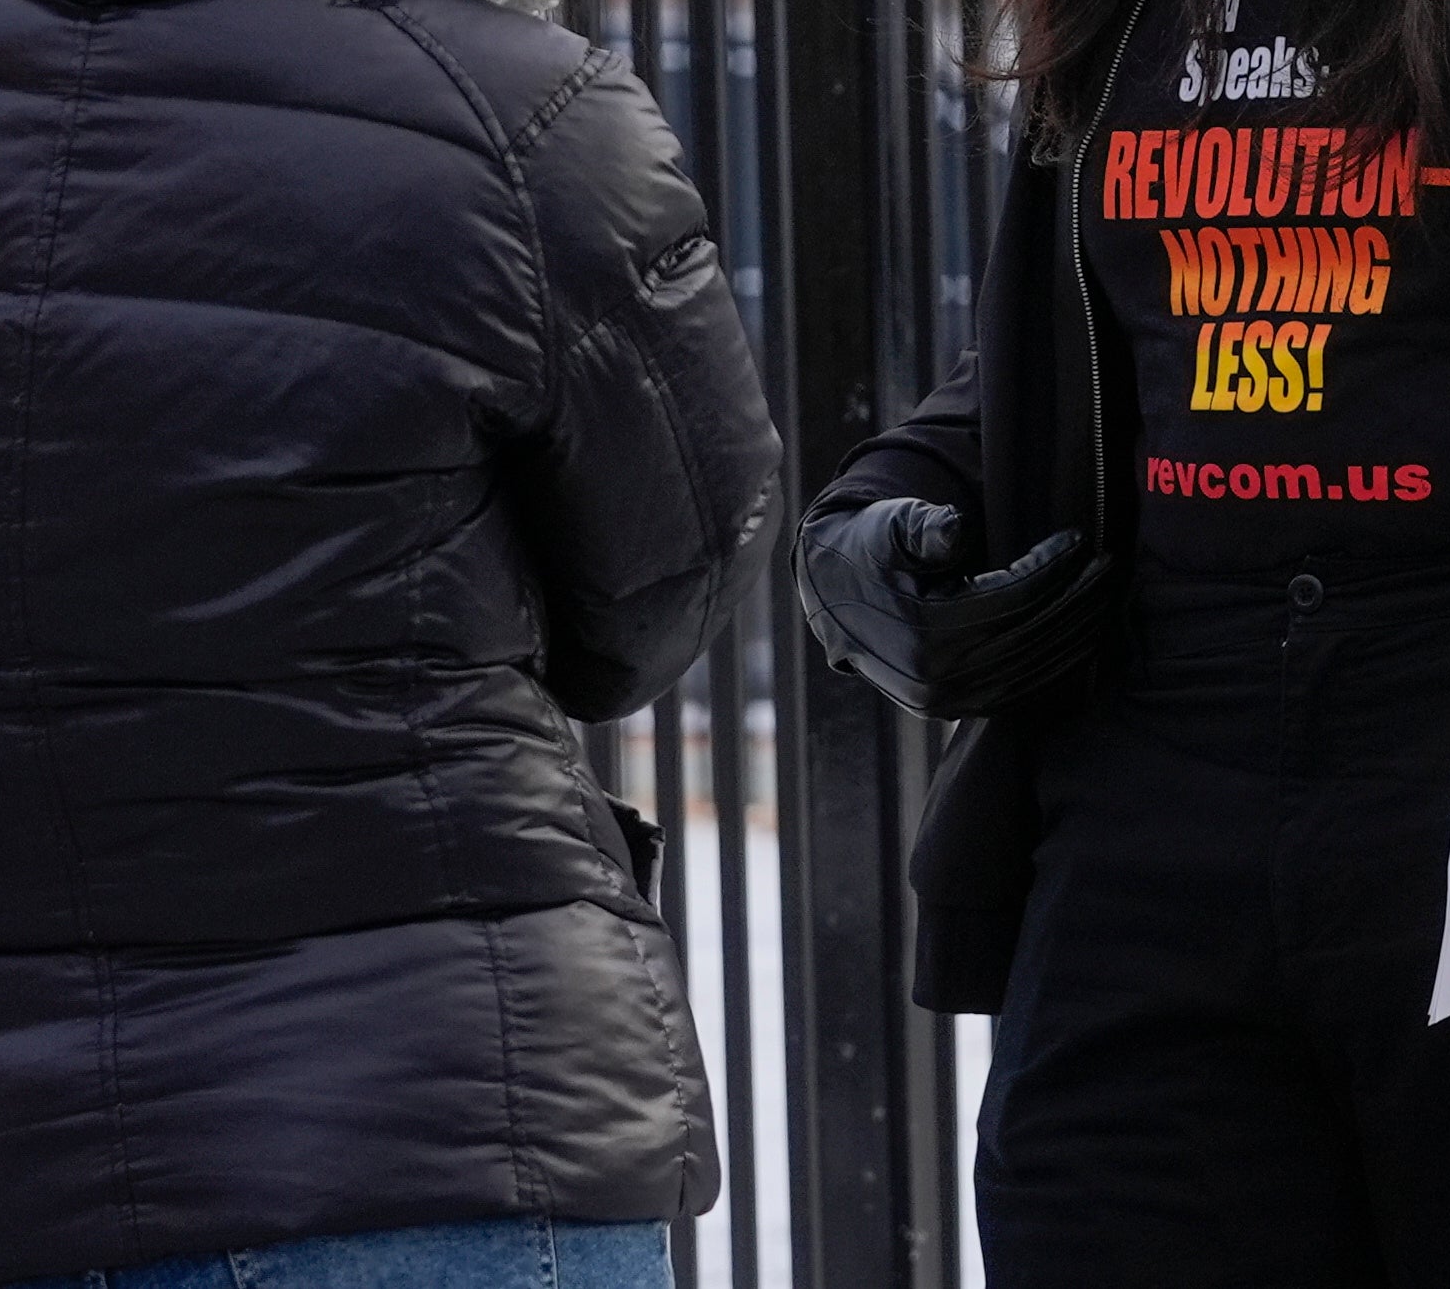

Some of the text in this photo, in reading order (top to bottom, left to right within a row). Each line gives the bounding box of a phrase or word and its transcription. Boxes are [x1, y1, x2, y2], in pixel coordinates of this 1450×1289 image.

[1159, 226, 1391, 316] NOTHING
[1190, 320, 1332, 413] LESS!
[1147, 457, 1432, 501] revcom.us
